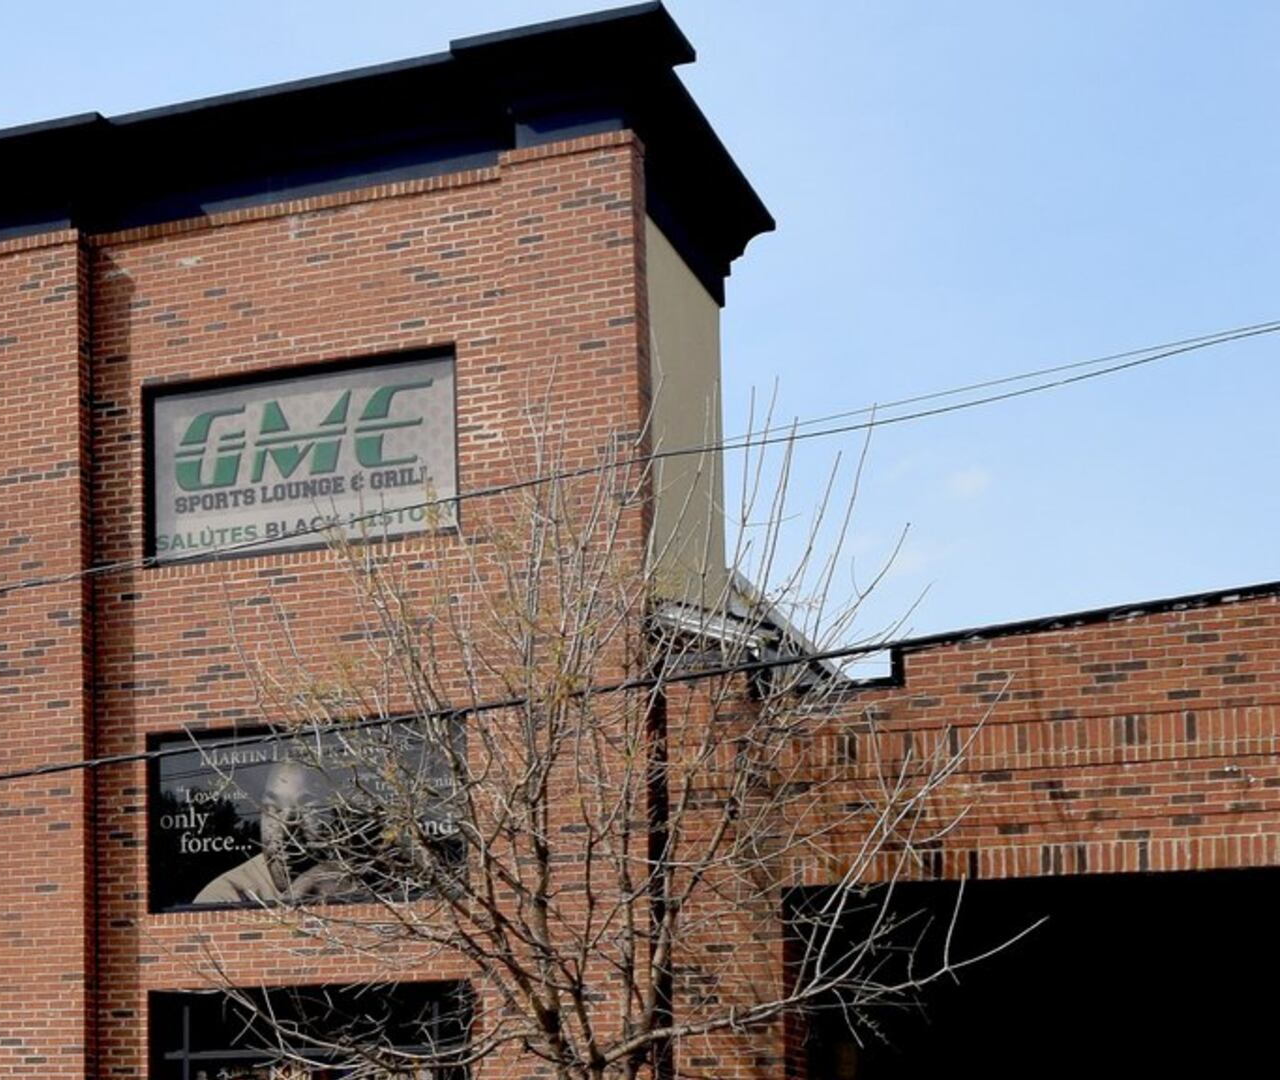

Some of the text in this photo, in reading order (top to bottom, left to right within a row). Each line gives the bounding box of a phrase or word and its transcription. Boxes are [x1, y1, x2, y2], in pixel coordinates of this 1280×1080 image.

[174, 377, 434, 493] GMC
[174, 487, 256, 515] SPORTS
[261, 474, 345, 502] LOUNGE
[156, 525, 258, 552] SALUTES
[160, 807, 209, 835] only
[181, 832, 252, 853] force...
